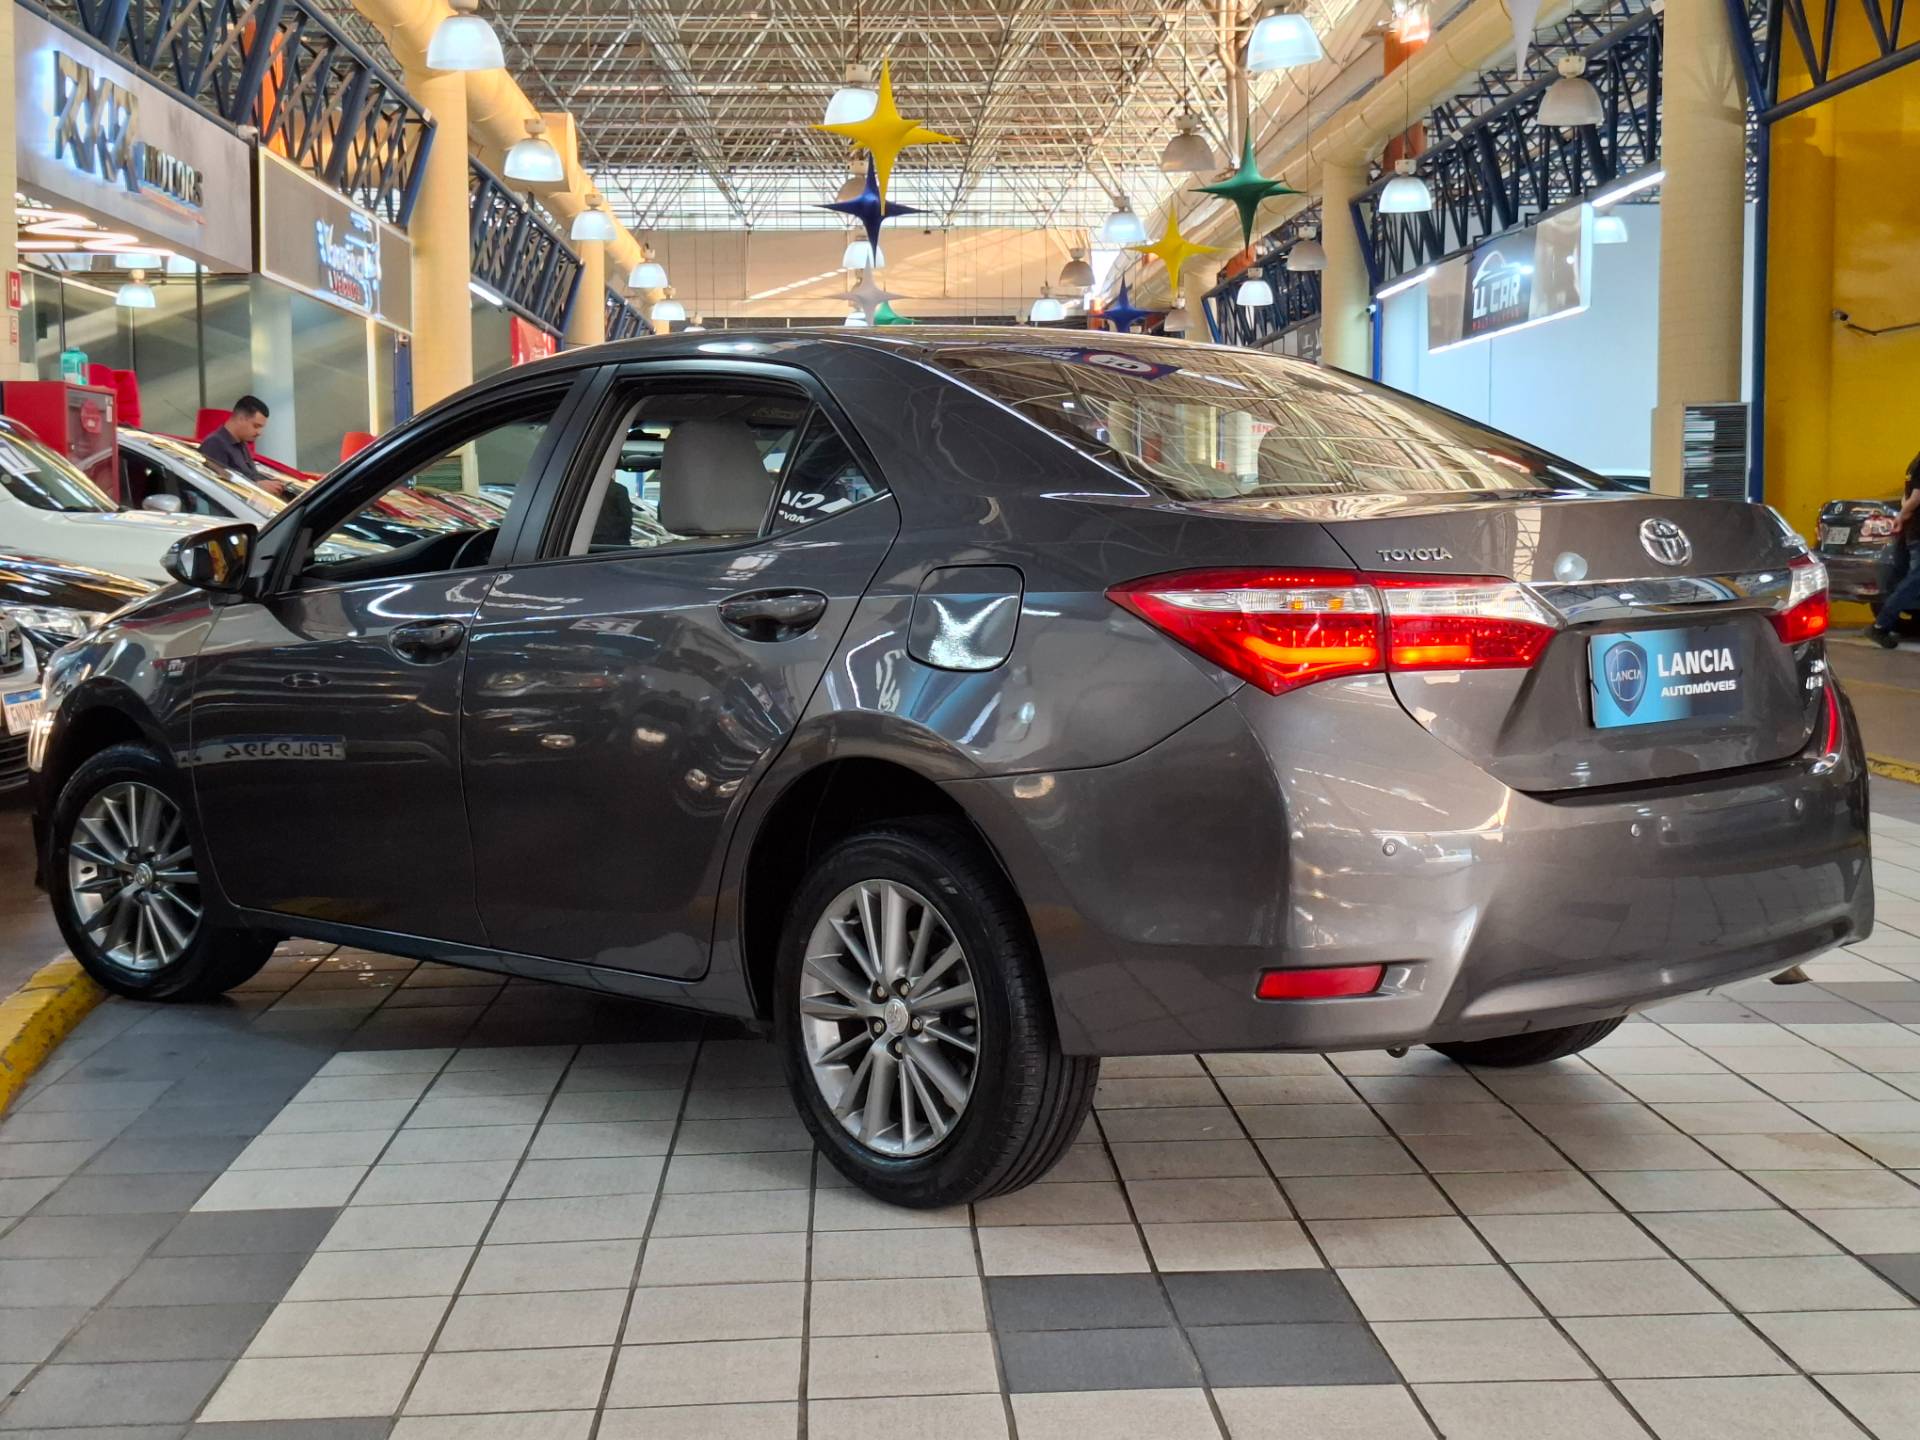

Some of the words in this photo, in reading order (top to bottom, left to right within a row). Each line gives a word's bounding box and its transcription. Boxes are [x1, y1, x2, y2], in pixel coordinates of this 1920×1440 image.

[136, 141, 203, 208] MOTORS
[1490, 272, 1520, 313] CAR
[1376, 546, 1453, 561] TOYOTA
[1657, 648, 1735, 677] LANCIA
[1610, 668, 1642, 682] LANCIA
[1661, 679, 1736, 697] AUTOMÓVEIS
